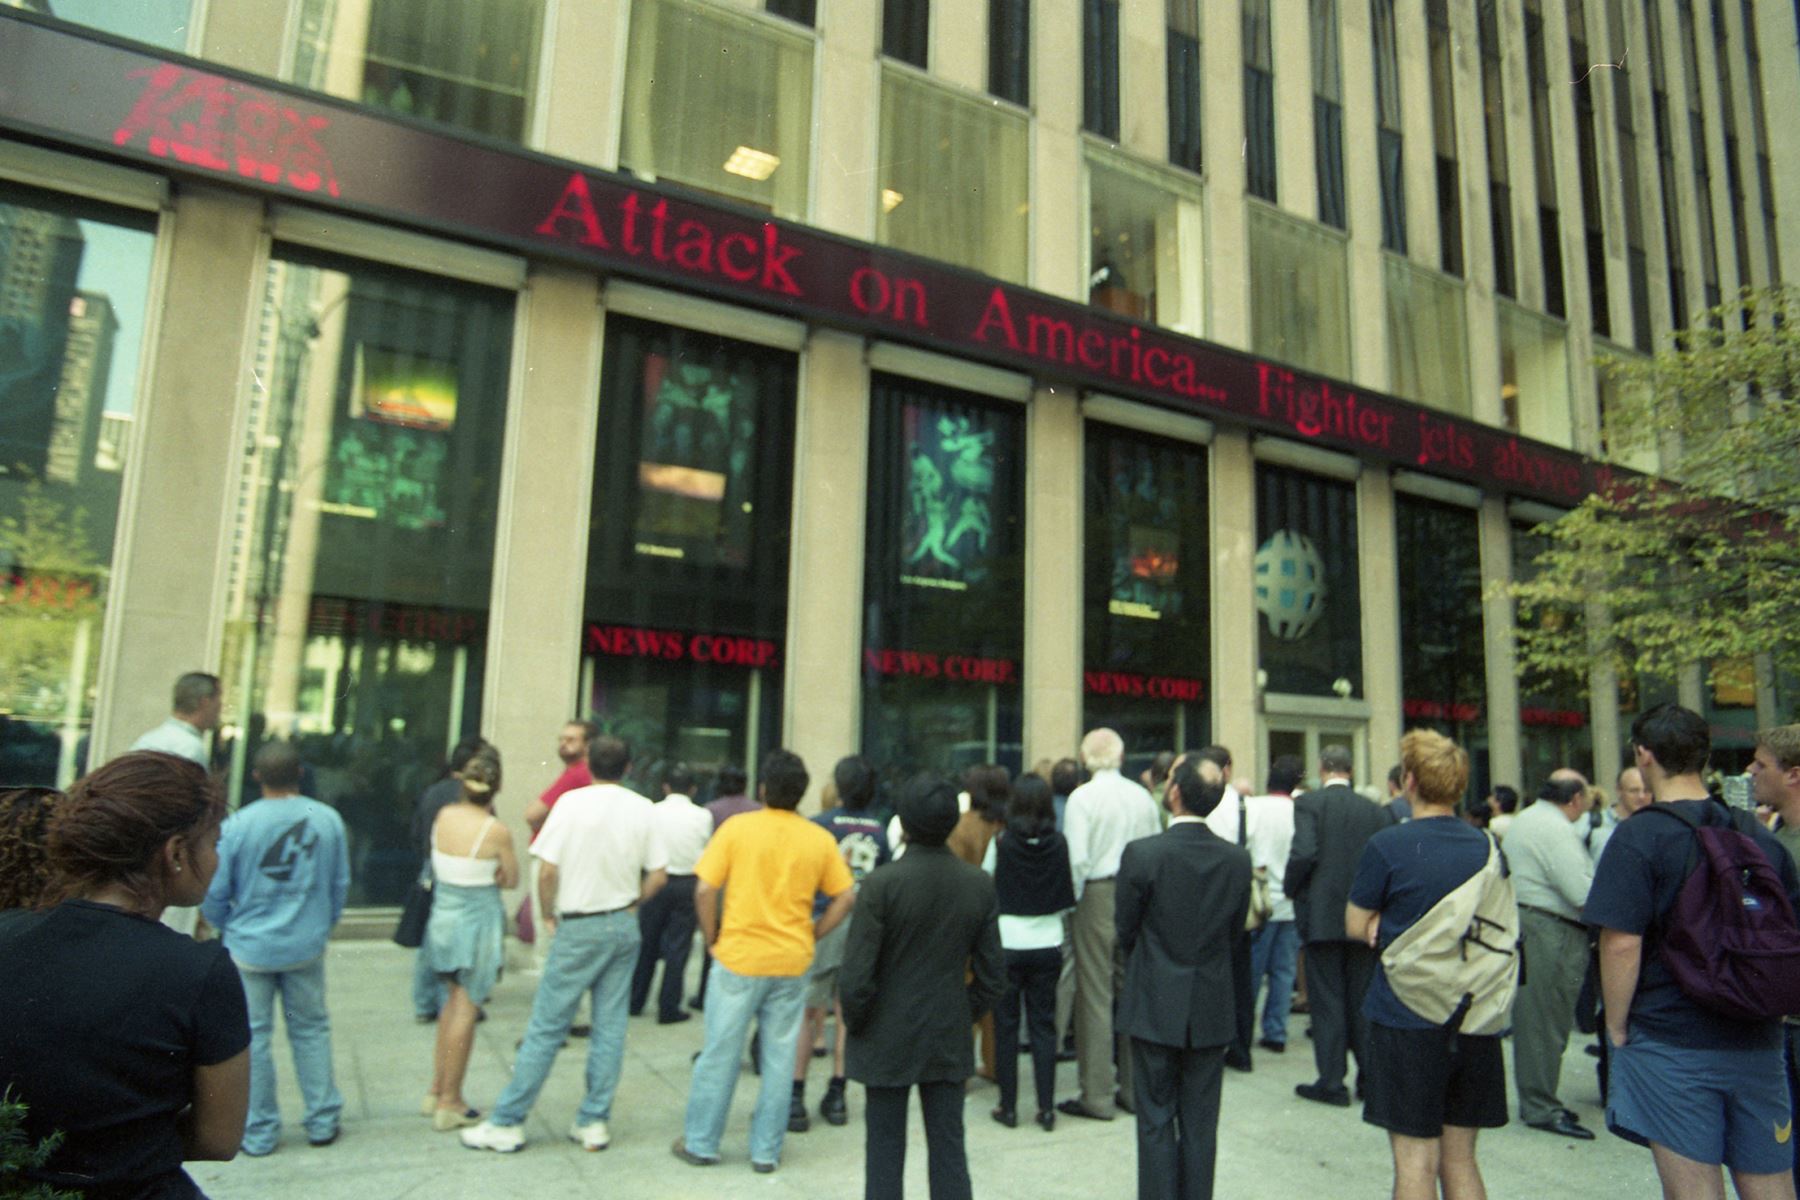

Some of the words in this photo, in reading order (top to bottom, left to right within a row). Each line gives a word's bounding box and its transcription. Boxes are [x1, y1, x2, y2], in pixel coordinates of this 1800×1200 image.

[534, 170, 804, 296] Attack
[849, 266, 928, 329] on
[1254, 361, 1394, 447] Fighter
[1416, 411, 1476, 468] jets
[1494, 436, 1573, 496] above
[588, 623, 685, 660] NEWS
[688, 633, 779, 669] CORP.
[863, 647, 940, 679] NEWS
[1084, 670, 1144, 698] NEWS
